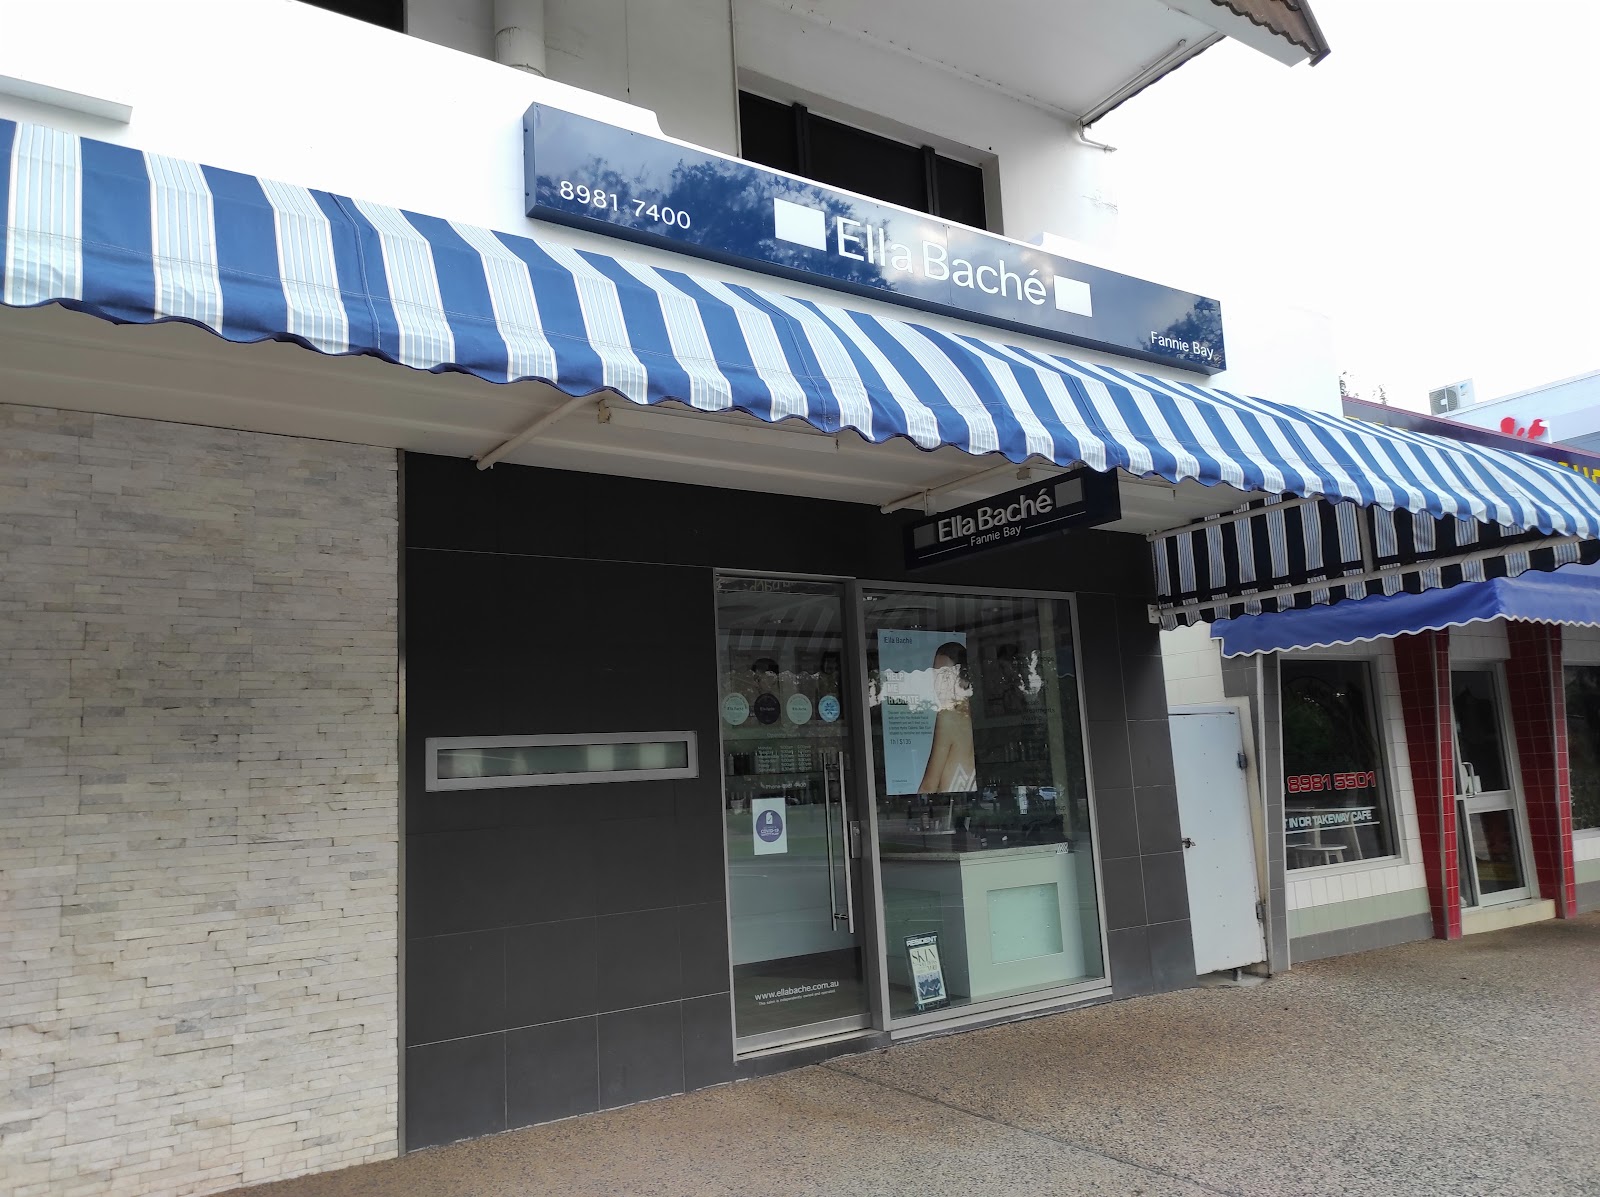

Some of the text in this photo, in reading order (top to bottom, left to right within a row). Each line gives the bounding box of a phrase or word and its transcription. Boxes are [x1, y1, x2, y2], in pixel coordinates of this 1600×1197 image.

[559, 180, 692, 230] 8981 7400
[836, 216, 1048, 306] Ella Baché
[1150, 330, 1215, 361] Fannie Bay
[938, 488, 1053, 542] Ella Baché
[970, 524, 1022, 547] Fannie Bay
[884, 636, 895, 644] Ella
[886, 672, 905, 681] HELP
[887, 683, 899, 693] ME
[887, 696, 920, 706] HYDRATE
[899, 738, 912, 746] $135
[1288, 772, 1375, 793] 8981 5501
[1289, 817, 1299, 829] IN
[1299, 816, 1312, 828] OR
[1312, 812, 1351, 826] TAKEWAY
[1351, 810, 1373, 822] CAFE
[906, 936, 937, 947] RESIDENT
[754, 980, 840, 1001] www.ellabache.com.au
